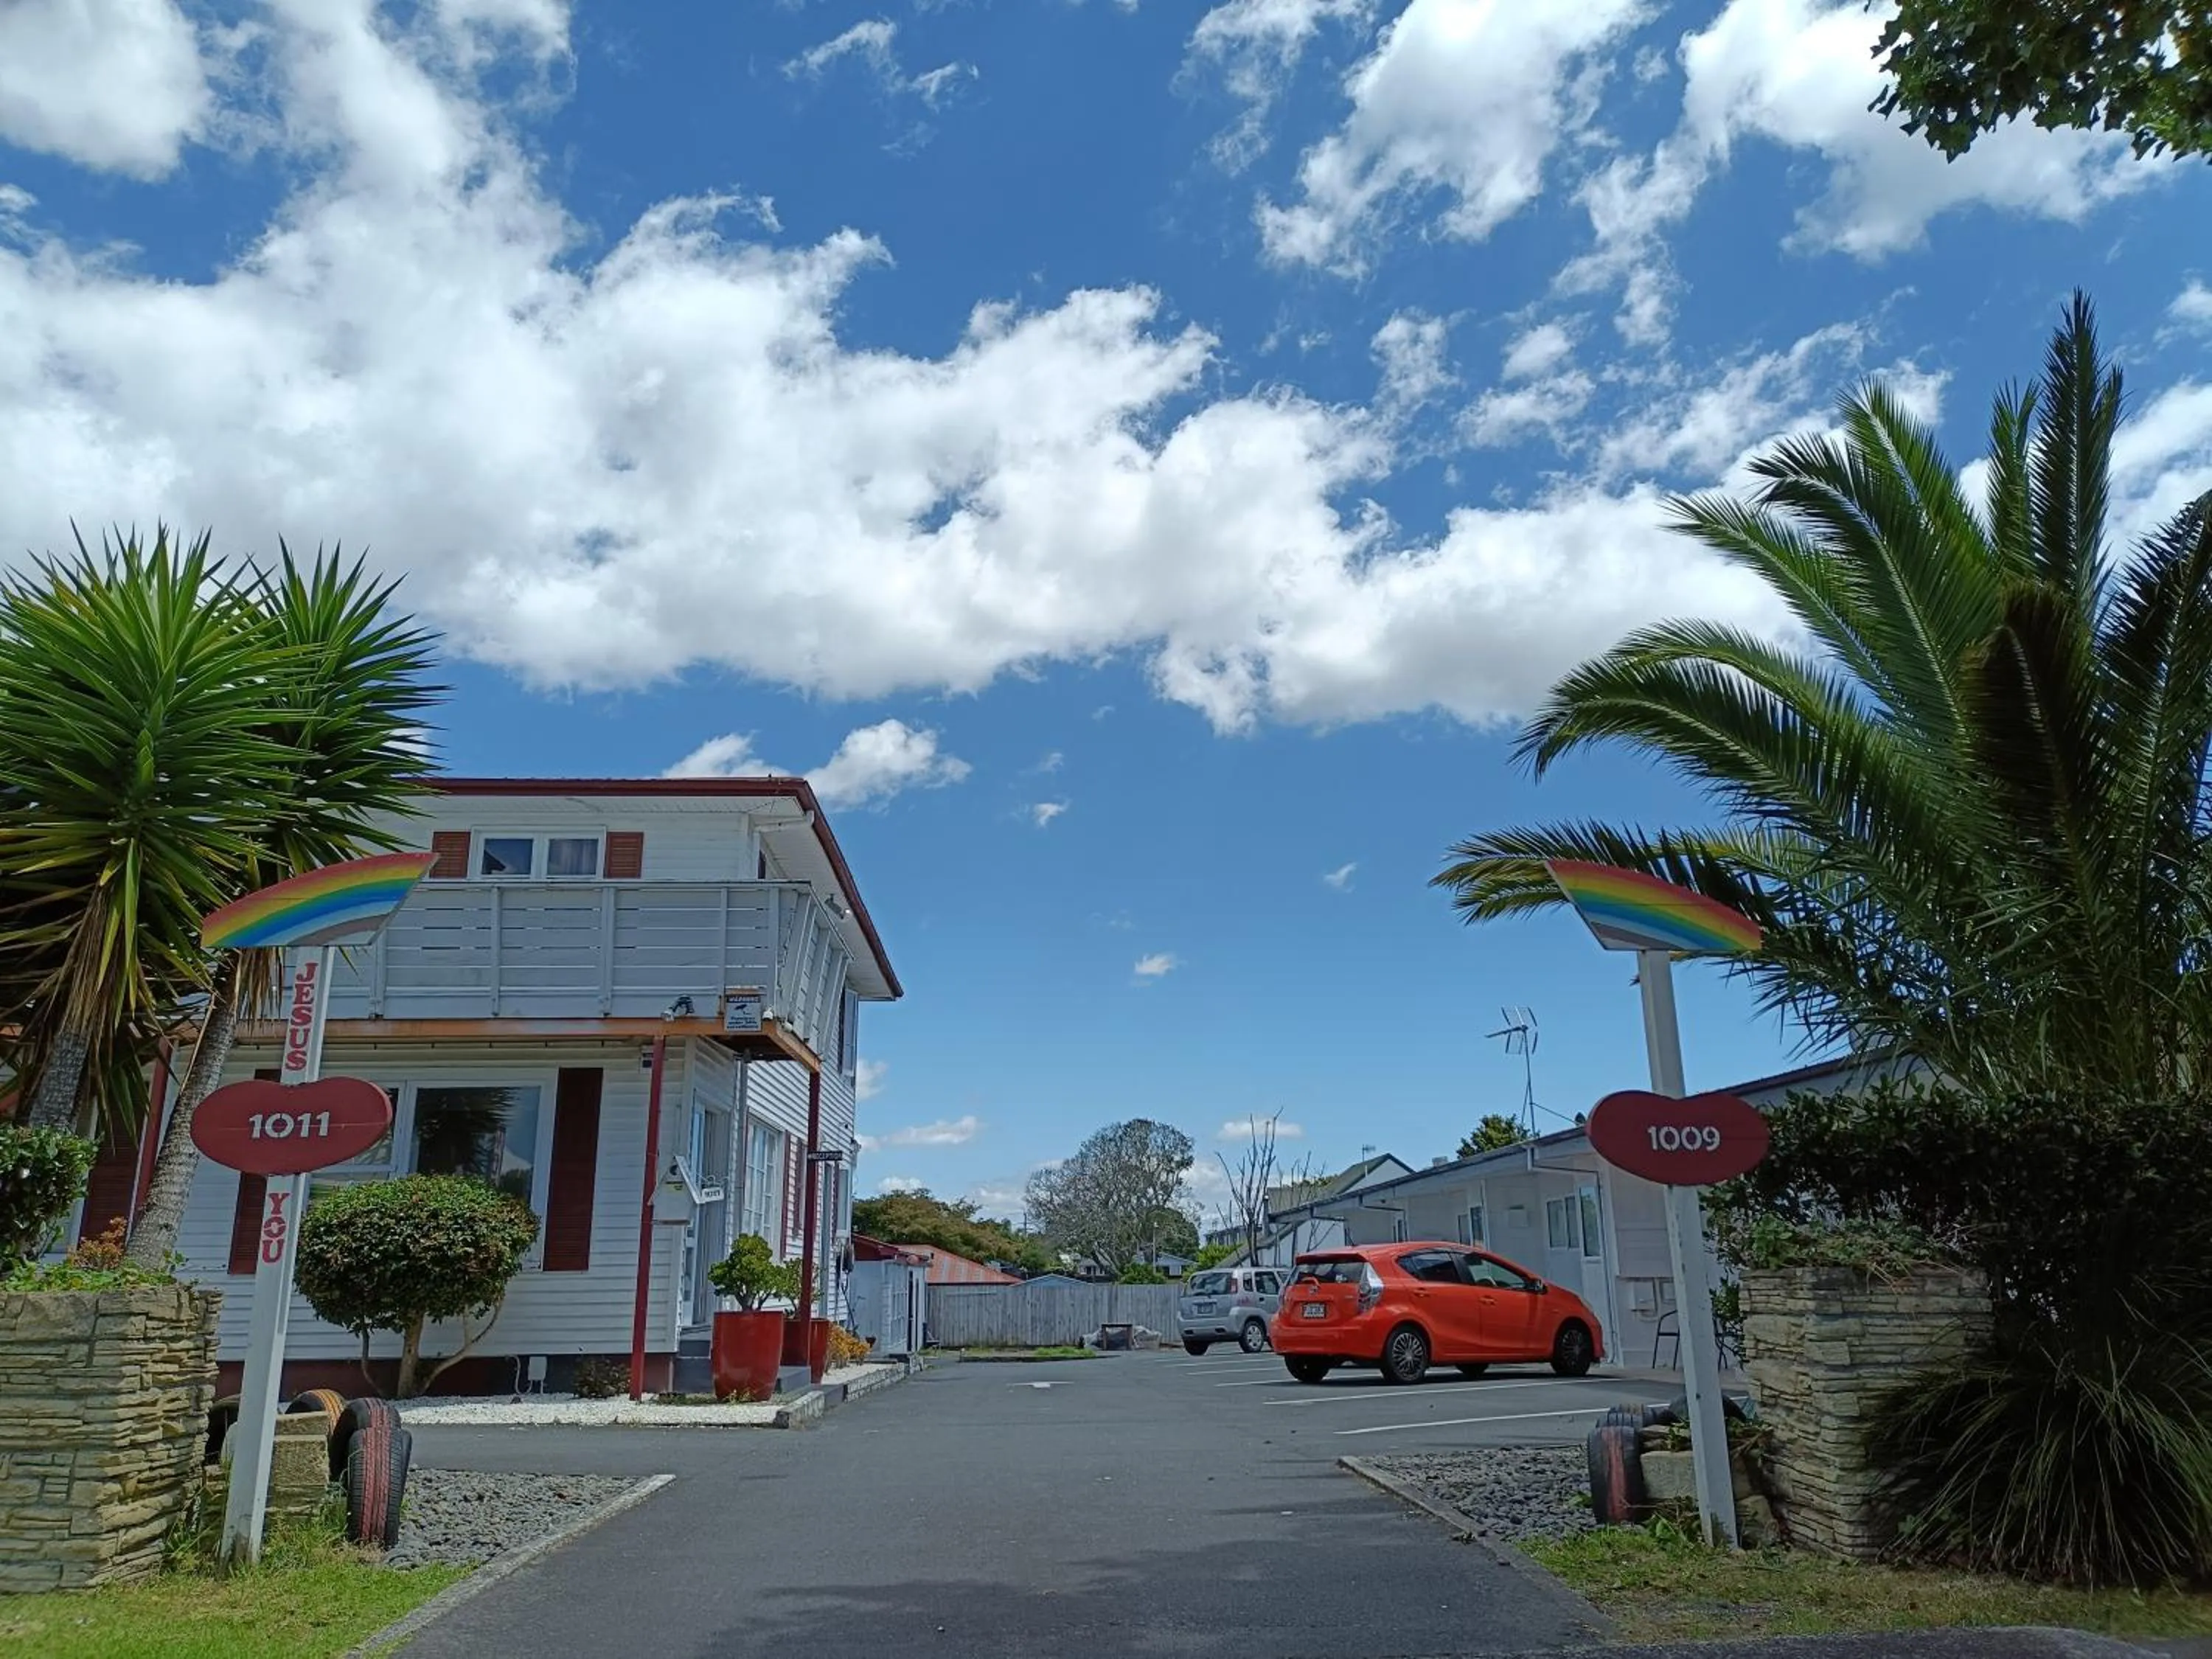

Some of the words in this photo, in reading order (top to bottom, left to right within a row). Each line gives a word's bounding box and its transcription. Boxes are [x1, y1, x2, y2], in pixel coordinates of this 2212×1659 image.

[285, 962, 319, 1071] JESUS
[248, 1112, 330, 1138] 1011
[1647, 1126, 1720, 1152] 1009
[262, 1192, 291, 1264] YOU
